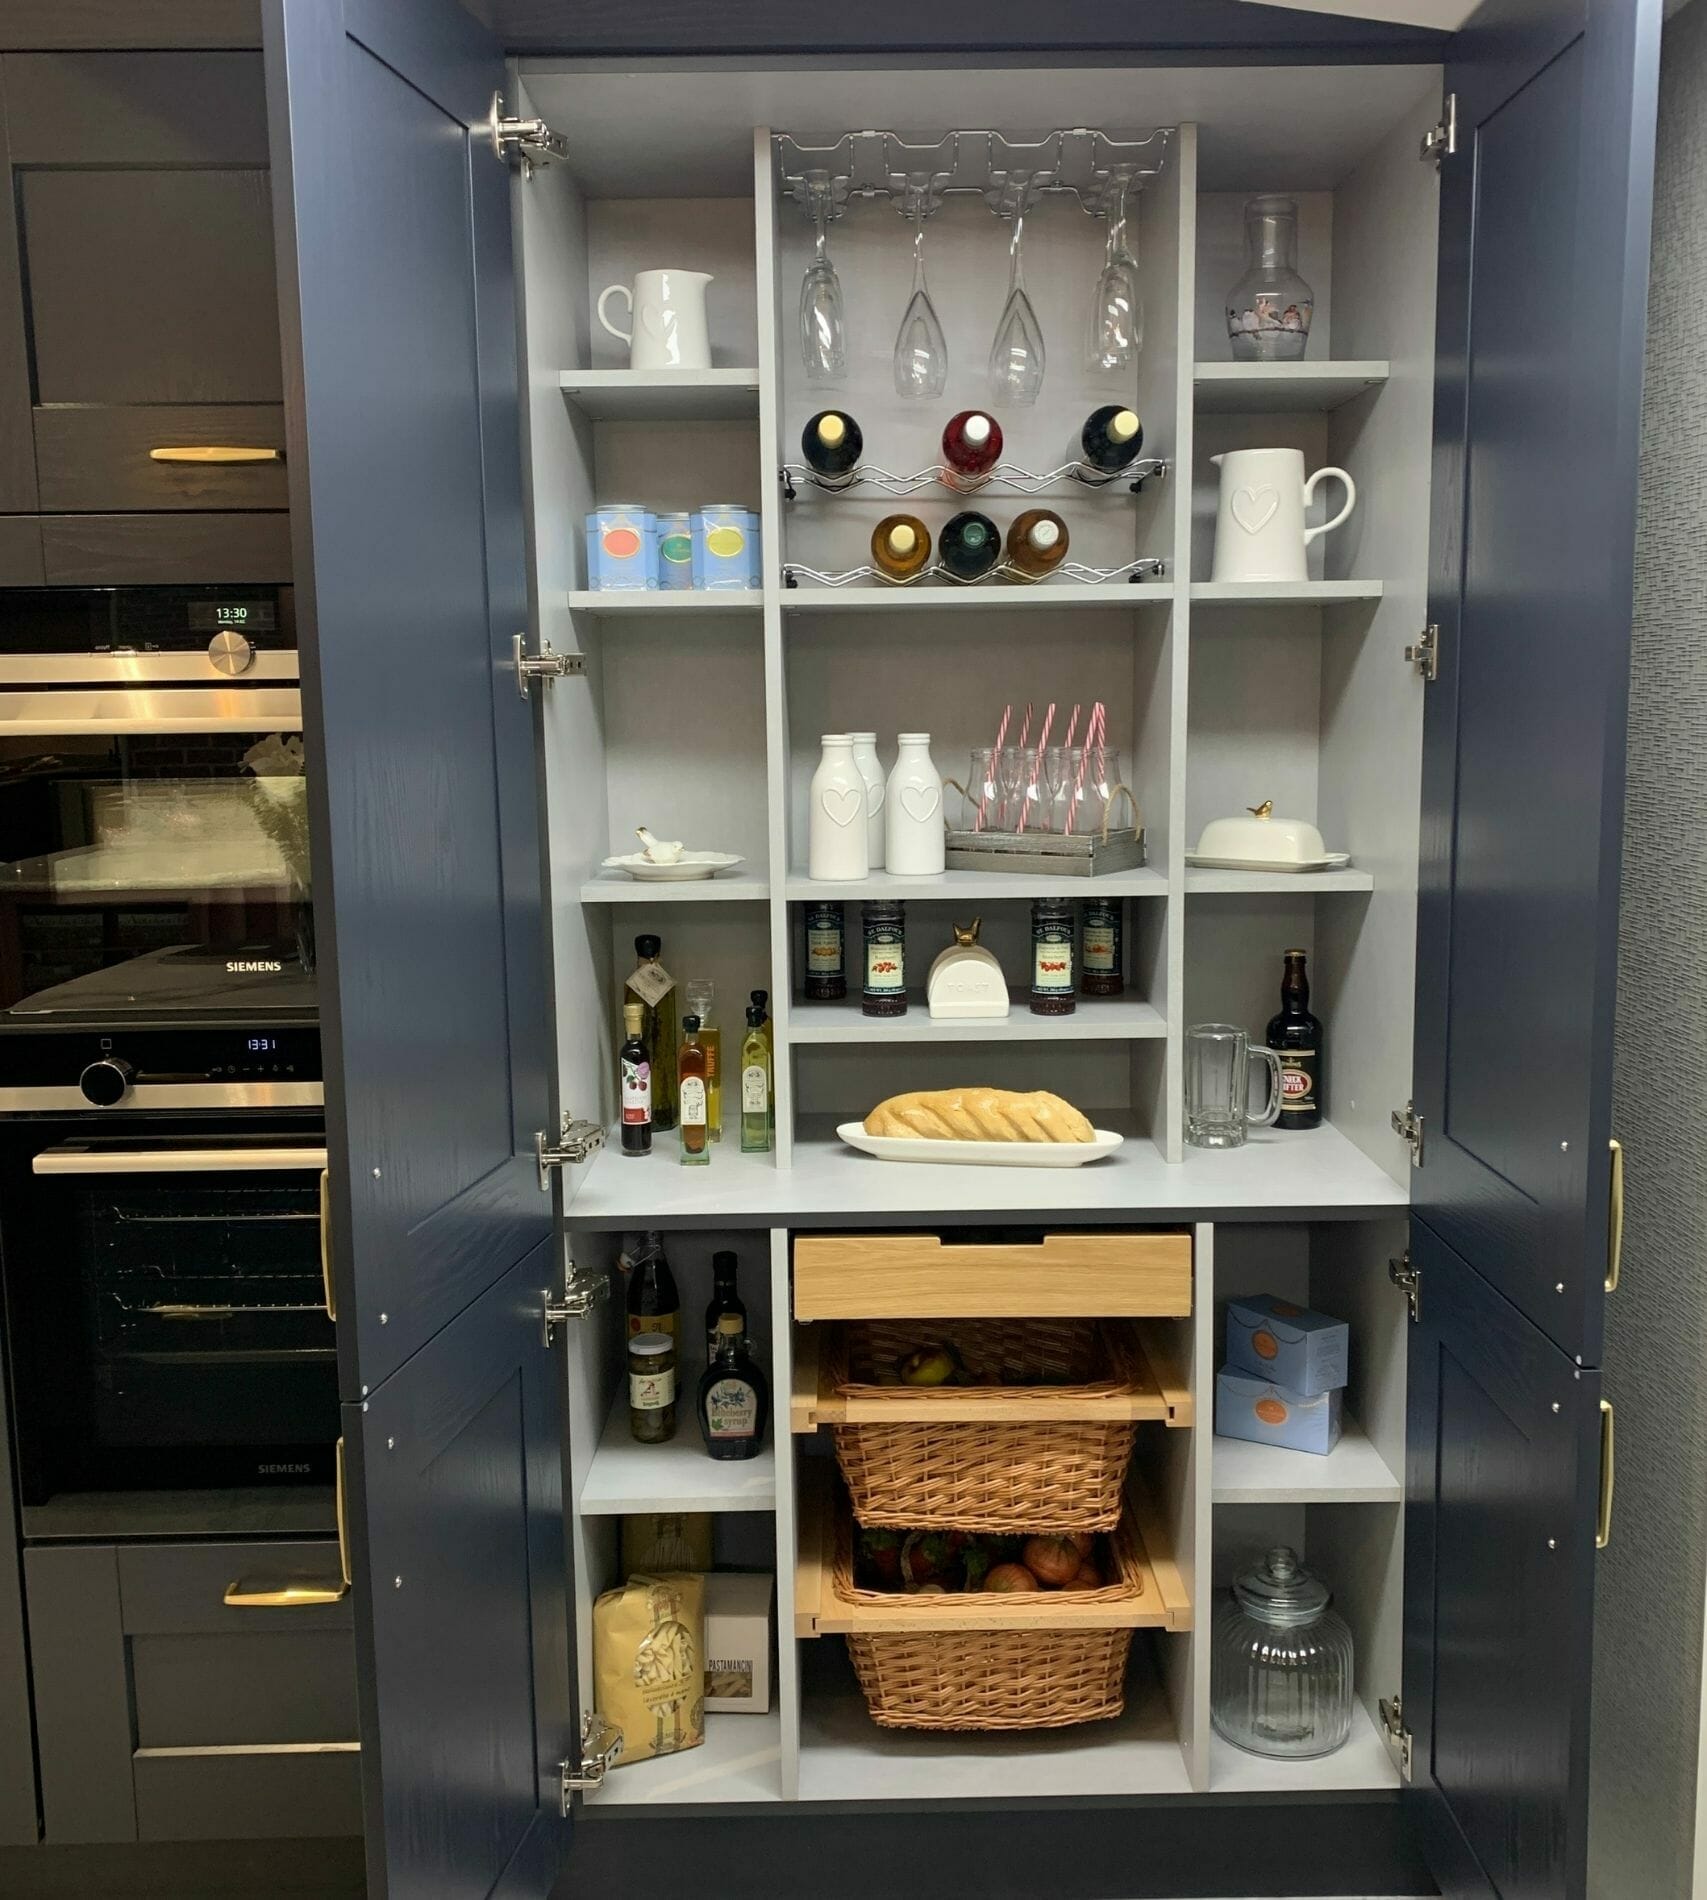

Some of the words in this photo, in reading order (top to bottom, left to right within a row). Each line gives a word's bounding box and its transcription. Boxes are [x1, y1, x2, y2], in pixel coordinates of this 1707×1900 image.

[216, 608, 247, 618] 13:30
[226, 961, 281, 972] SIEMENS
[1281, 1075, 1302, 1084] NECK
[1282, 1083, 1304, 1091] IFTER
[723, 1417, 748, 1428] syrup
[258, 1463, 311, 1474] SIEMENS
